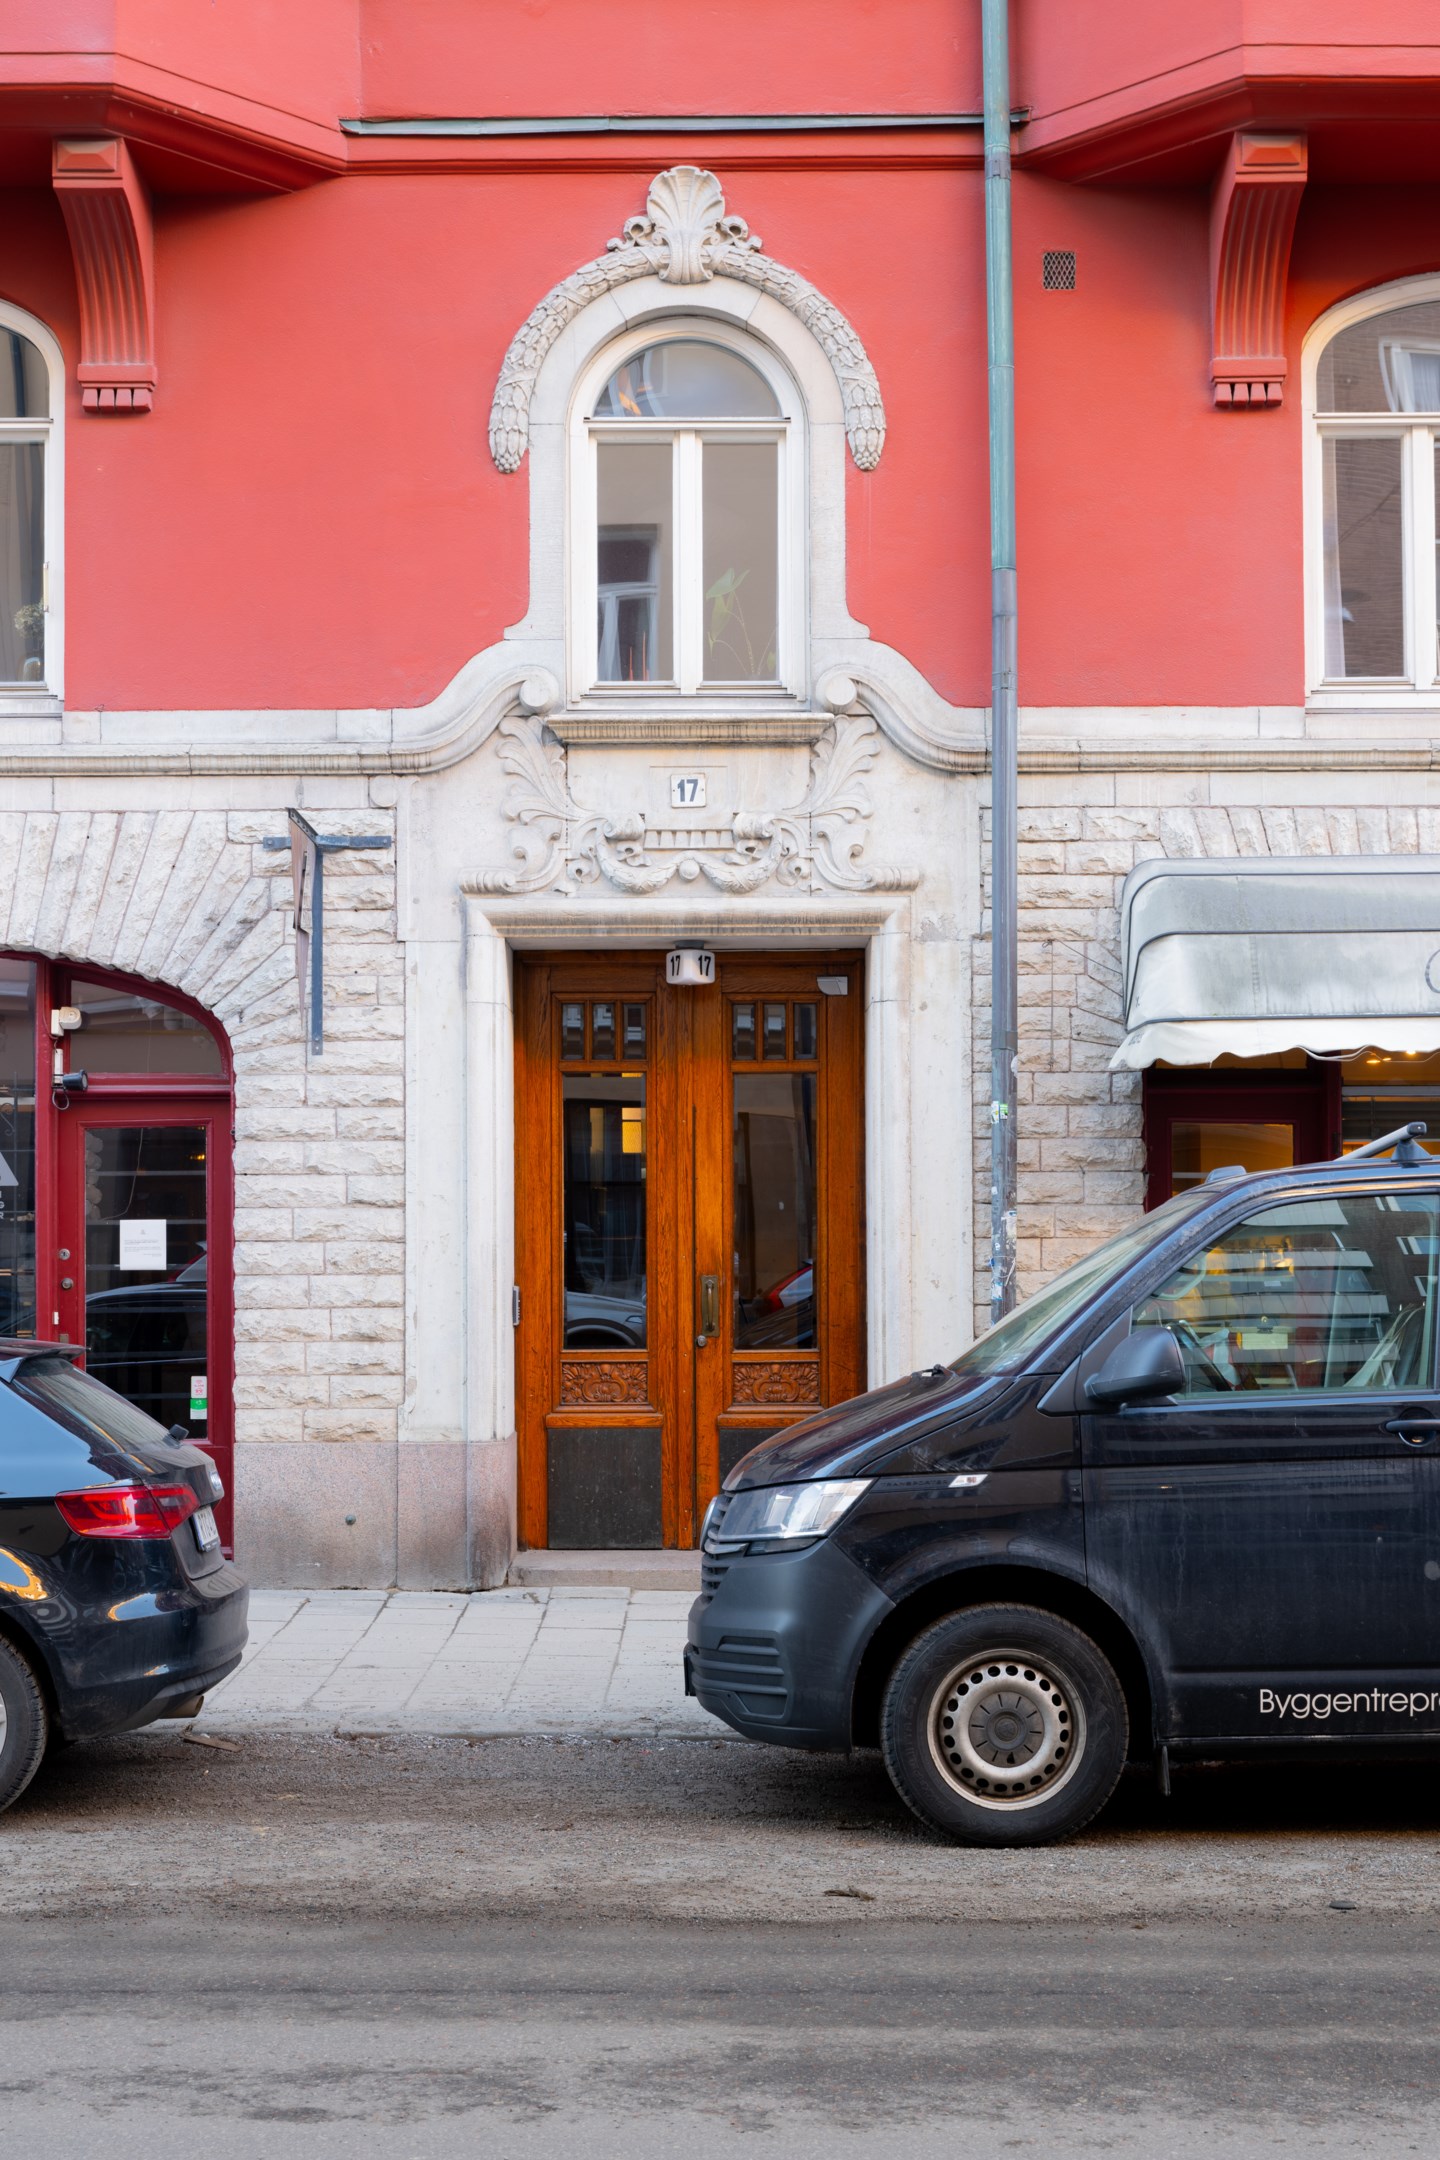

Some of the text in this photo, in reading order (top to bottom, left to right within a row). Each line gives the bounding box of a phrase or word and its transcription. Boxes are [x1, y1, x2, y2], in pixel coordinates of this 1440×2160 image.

[677, 778, 699, 802] 17
[670, 955, 681, 977] 17
[698, 955, 712, 977] 17
[1259, 1688, 1440, 1720] Byggentrepr
